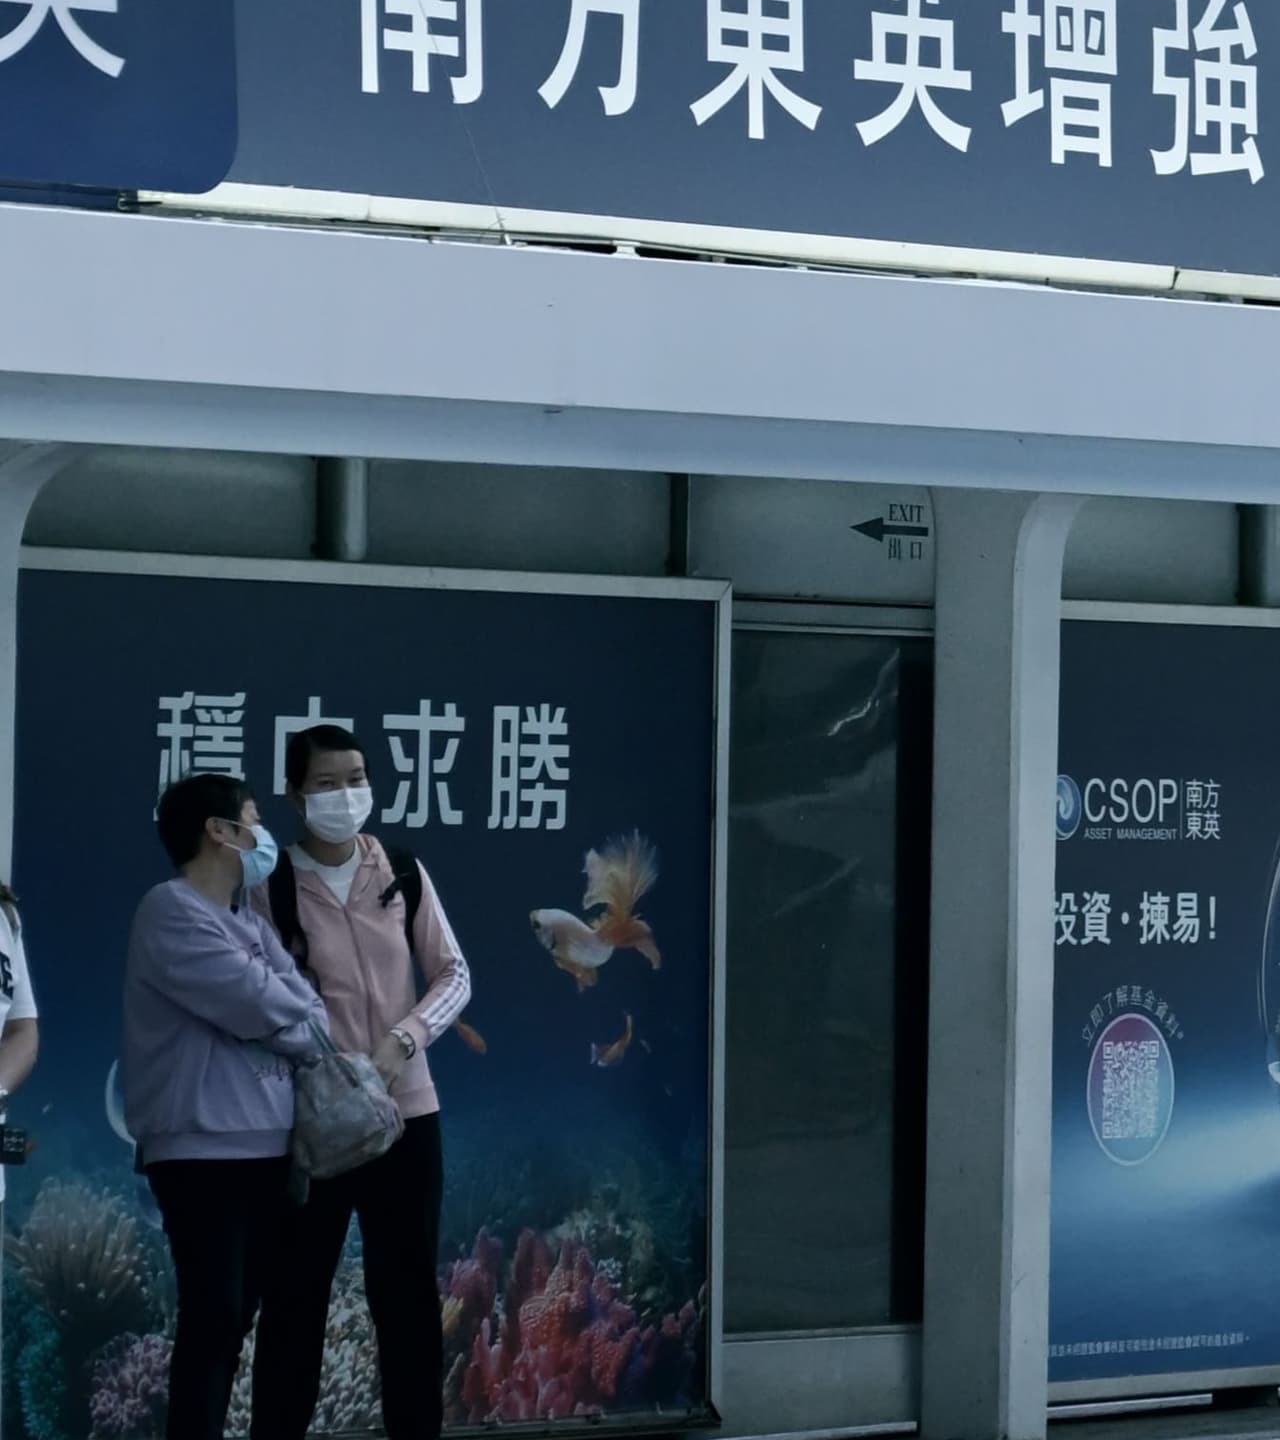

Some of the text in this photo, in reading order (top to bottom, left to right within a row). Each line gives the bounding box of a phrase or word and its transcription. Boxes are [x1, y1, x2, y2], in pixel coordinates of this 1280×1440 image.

[888, 504, 924, 522] EXIT
[888, 537, 922, 560] 出口
[1084, 778, 1178, 823] CSOP
[1185, 779, 1221, 809] 南方
[1083, 828, 1177, 841] ASSET MANAGEMENT
[1185, 811, 1221, 840] 東英
